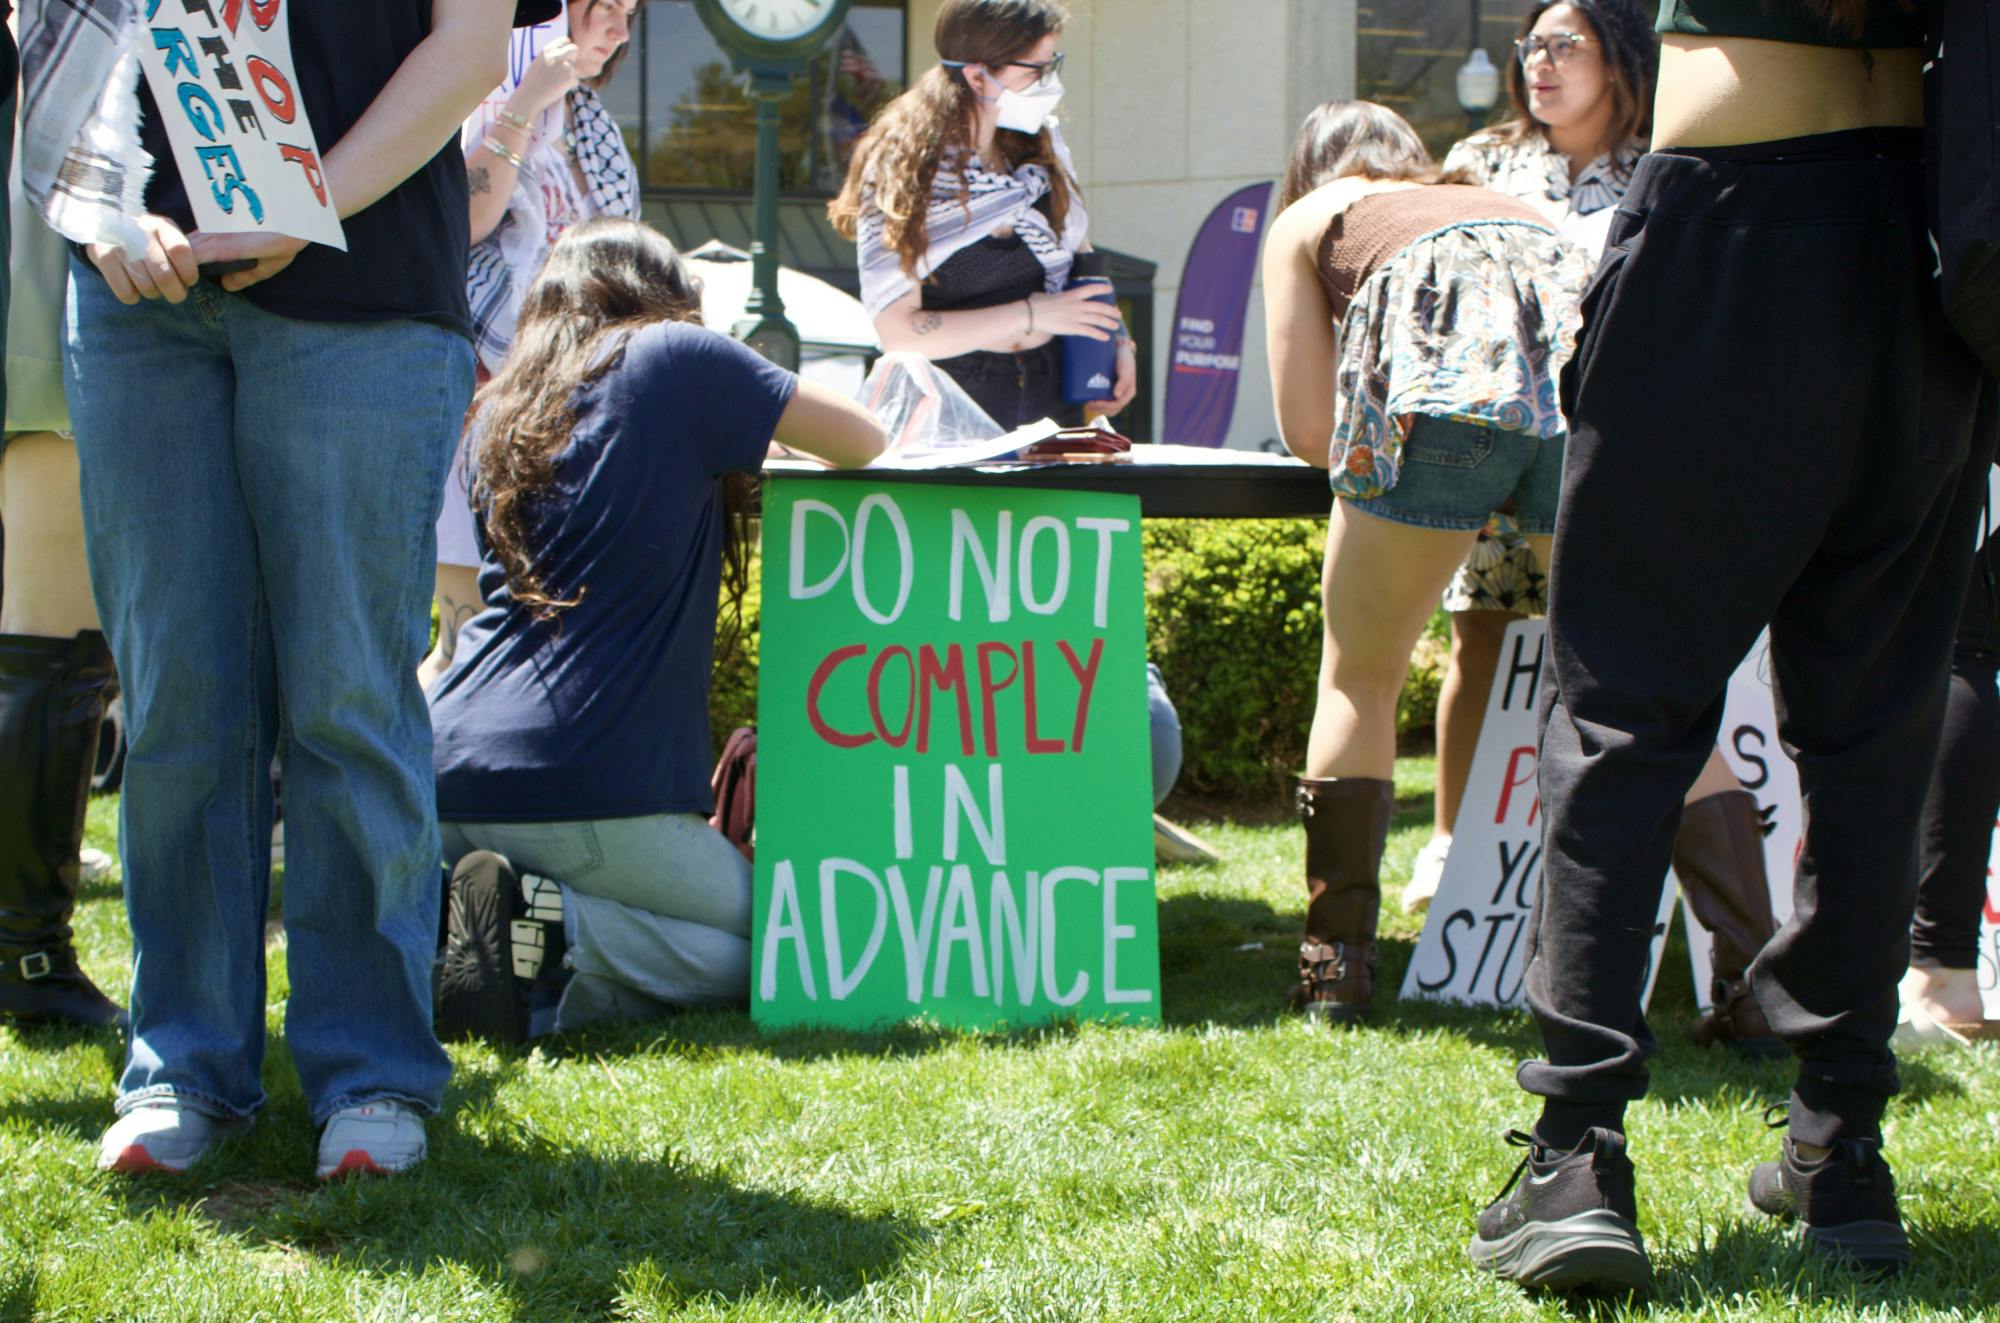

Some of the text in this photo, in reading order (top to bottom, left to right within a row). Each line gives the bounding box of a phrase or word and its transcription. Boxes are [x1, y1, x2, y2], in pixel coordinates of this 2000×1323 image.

[145, 0, 265, 226] RGES
[789, 493, 1130, 628] DO NOT
[806, 638, 1105, 758] COMPLY
[891, 763, 1007, 866] IN
[759, 857, 1153, 1008] ADVANCE
[1416, 908, 1527, 1004] STU
